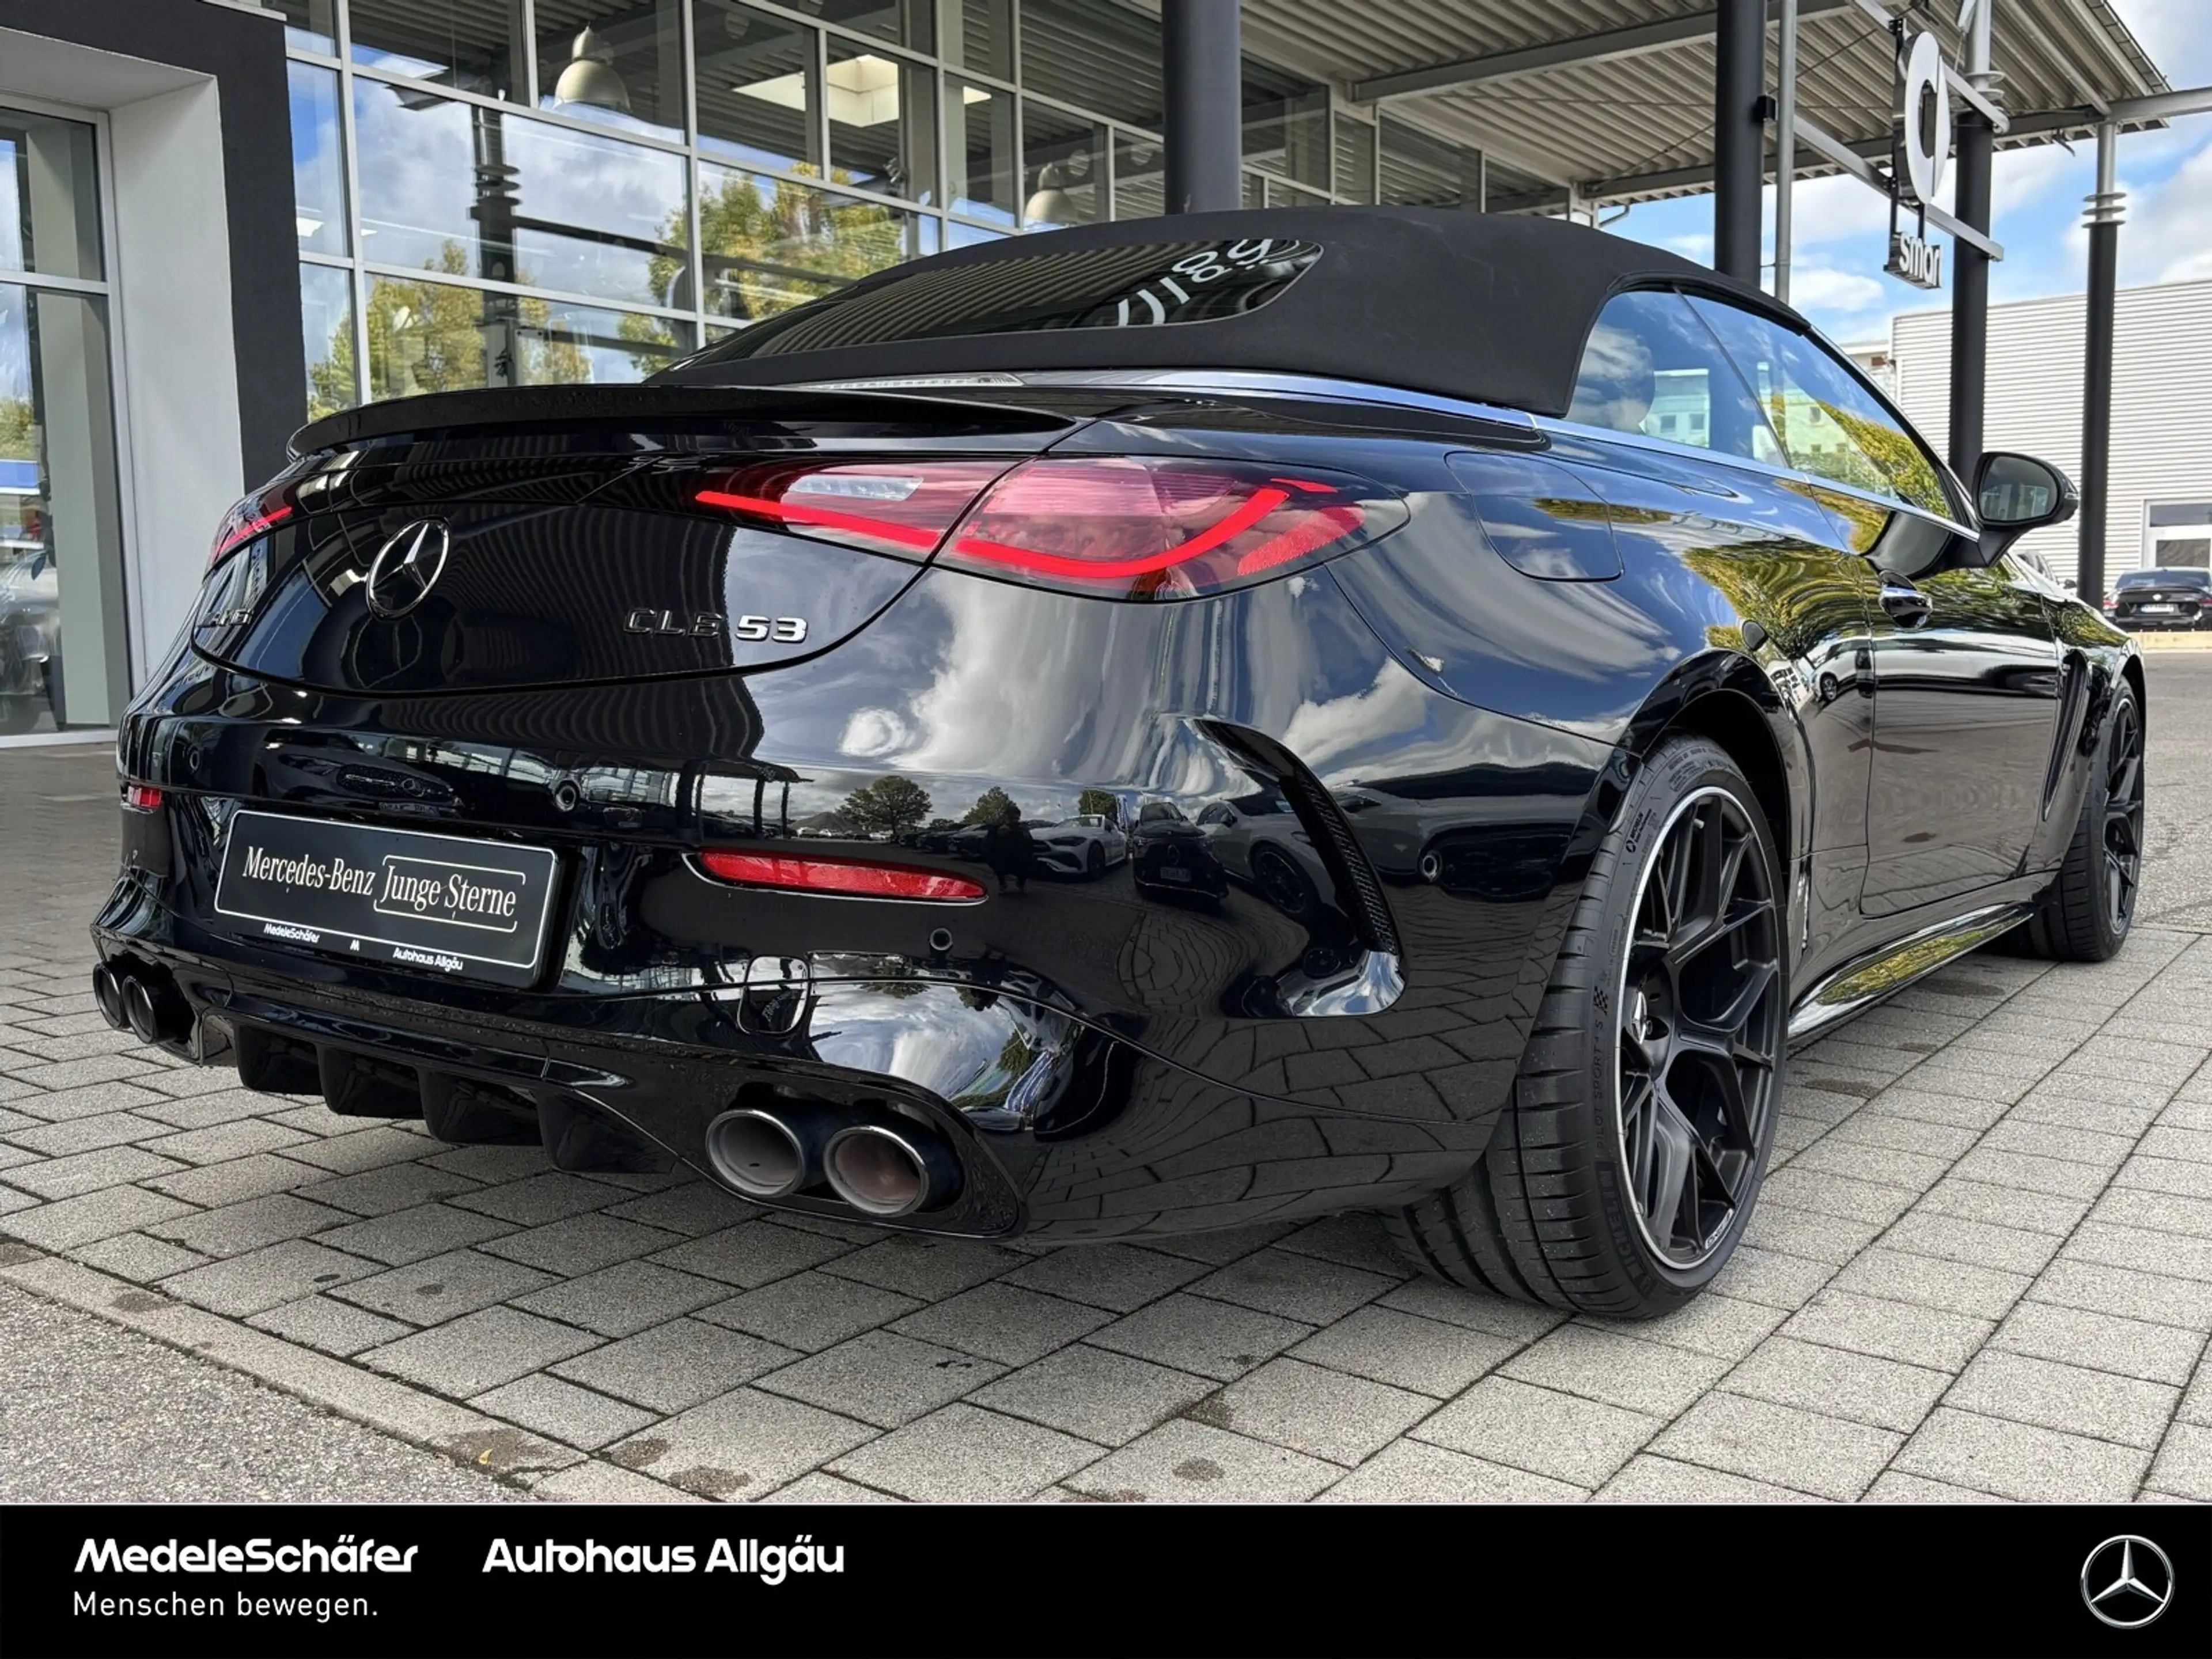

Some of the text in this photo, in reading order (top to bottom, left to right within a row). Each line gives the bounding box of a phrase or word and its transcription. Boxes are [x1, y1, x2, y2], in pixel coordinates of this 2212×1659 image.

[623, 608, 808, 643] CLE 53
[242, 846, 516, 917] Mercedes-Benz Junge Sterne
[263, 923, 320, 944] MedeleSchäfer
[392, 947, 463, 972] Autohaus Allgäu
